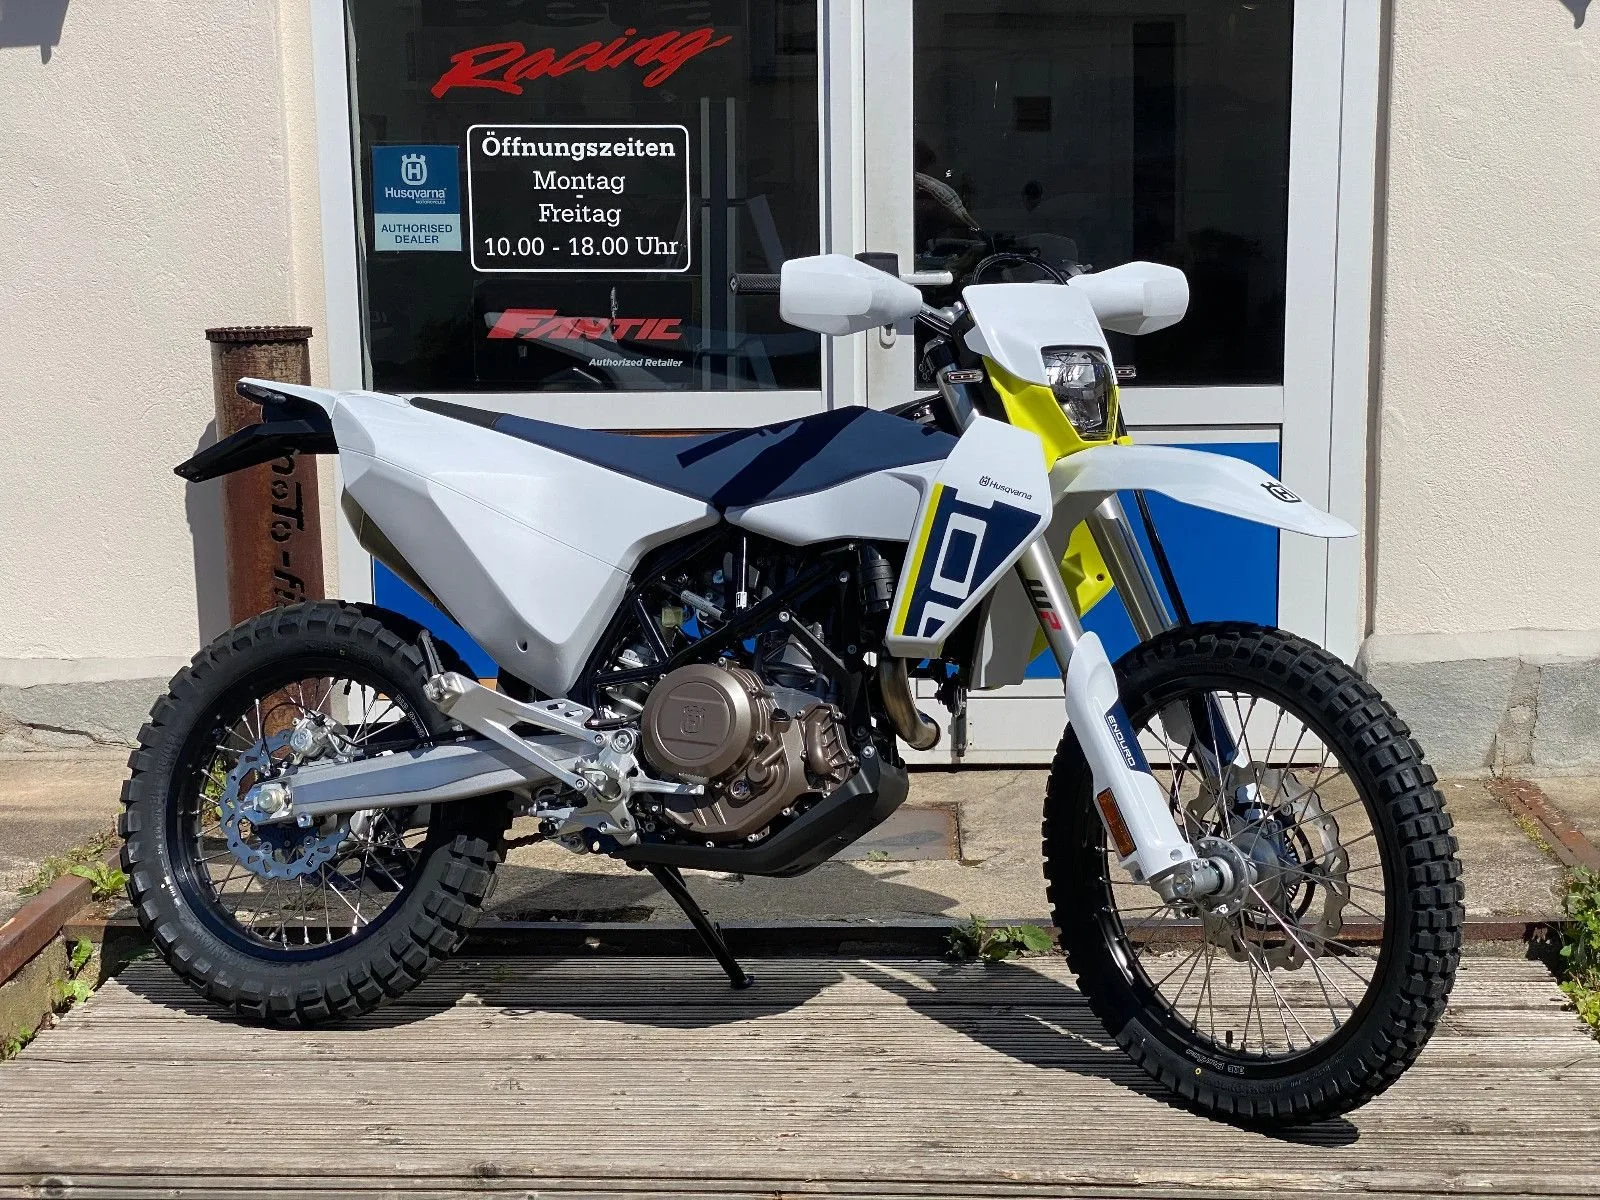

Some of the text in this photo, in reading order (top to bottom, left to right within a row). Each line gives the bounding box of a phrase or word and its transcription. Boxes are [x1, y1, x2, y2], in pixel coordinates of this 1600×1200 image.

[431, 28, 732, 99] Racing
[481, 131, 676, 161] Öffnungszeiten
[533, 170, 626, 194] Montag
[385, 187, 446, 200] Husqvarna
[539, 203, 622, 227] Freitag
[381, 224, 453, 233] AUTHORISED
[395, 235, 439, 244] DEALER
[484, 237, 545, 256] 10.00
[568, 236, 629, 256] 18.00
[635, 236, 679, 255] Uhr
[487, 309, 683, 340] FANTIC
[589, 358, 683, 367] Authorized Retailer
[990, 480, 1033, 500] Husqvarna
[1108, 715, 1136, 767] ENDURO
